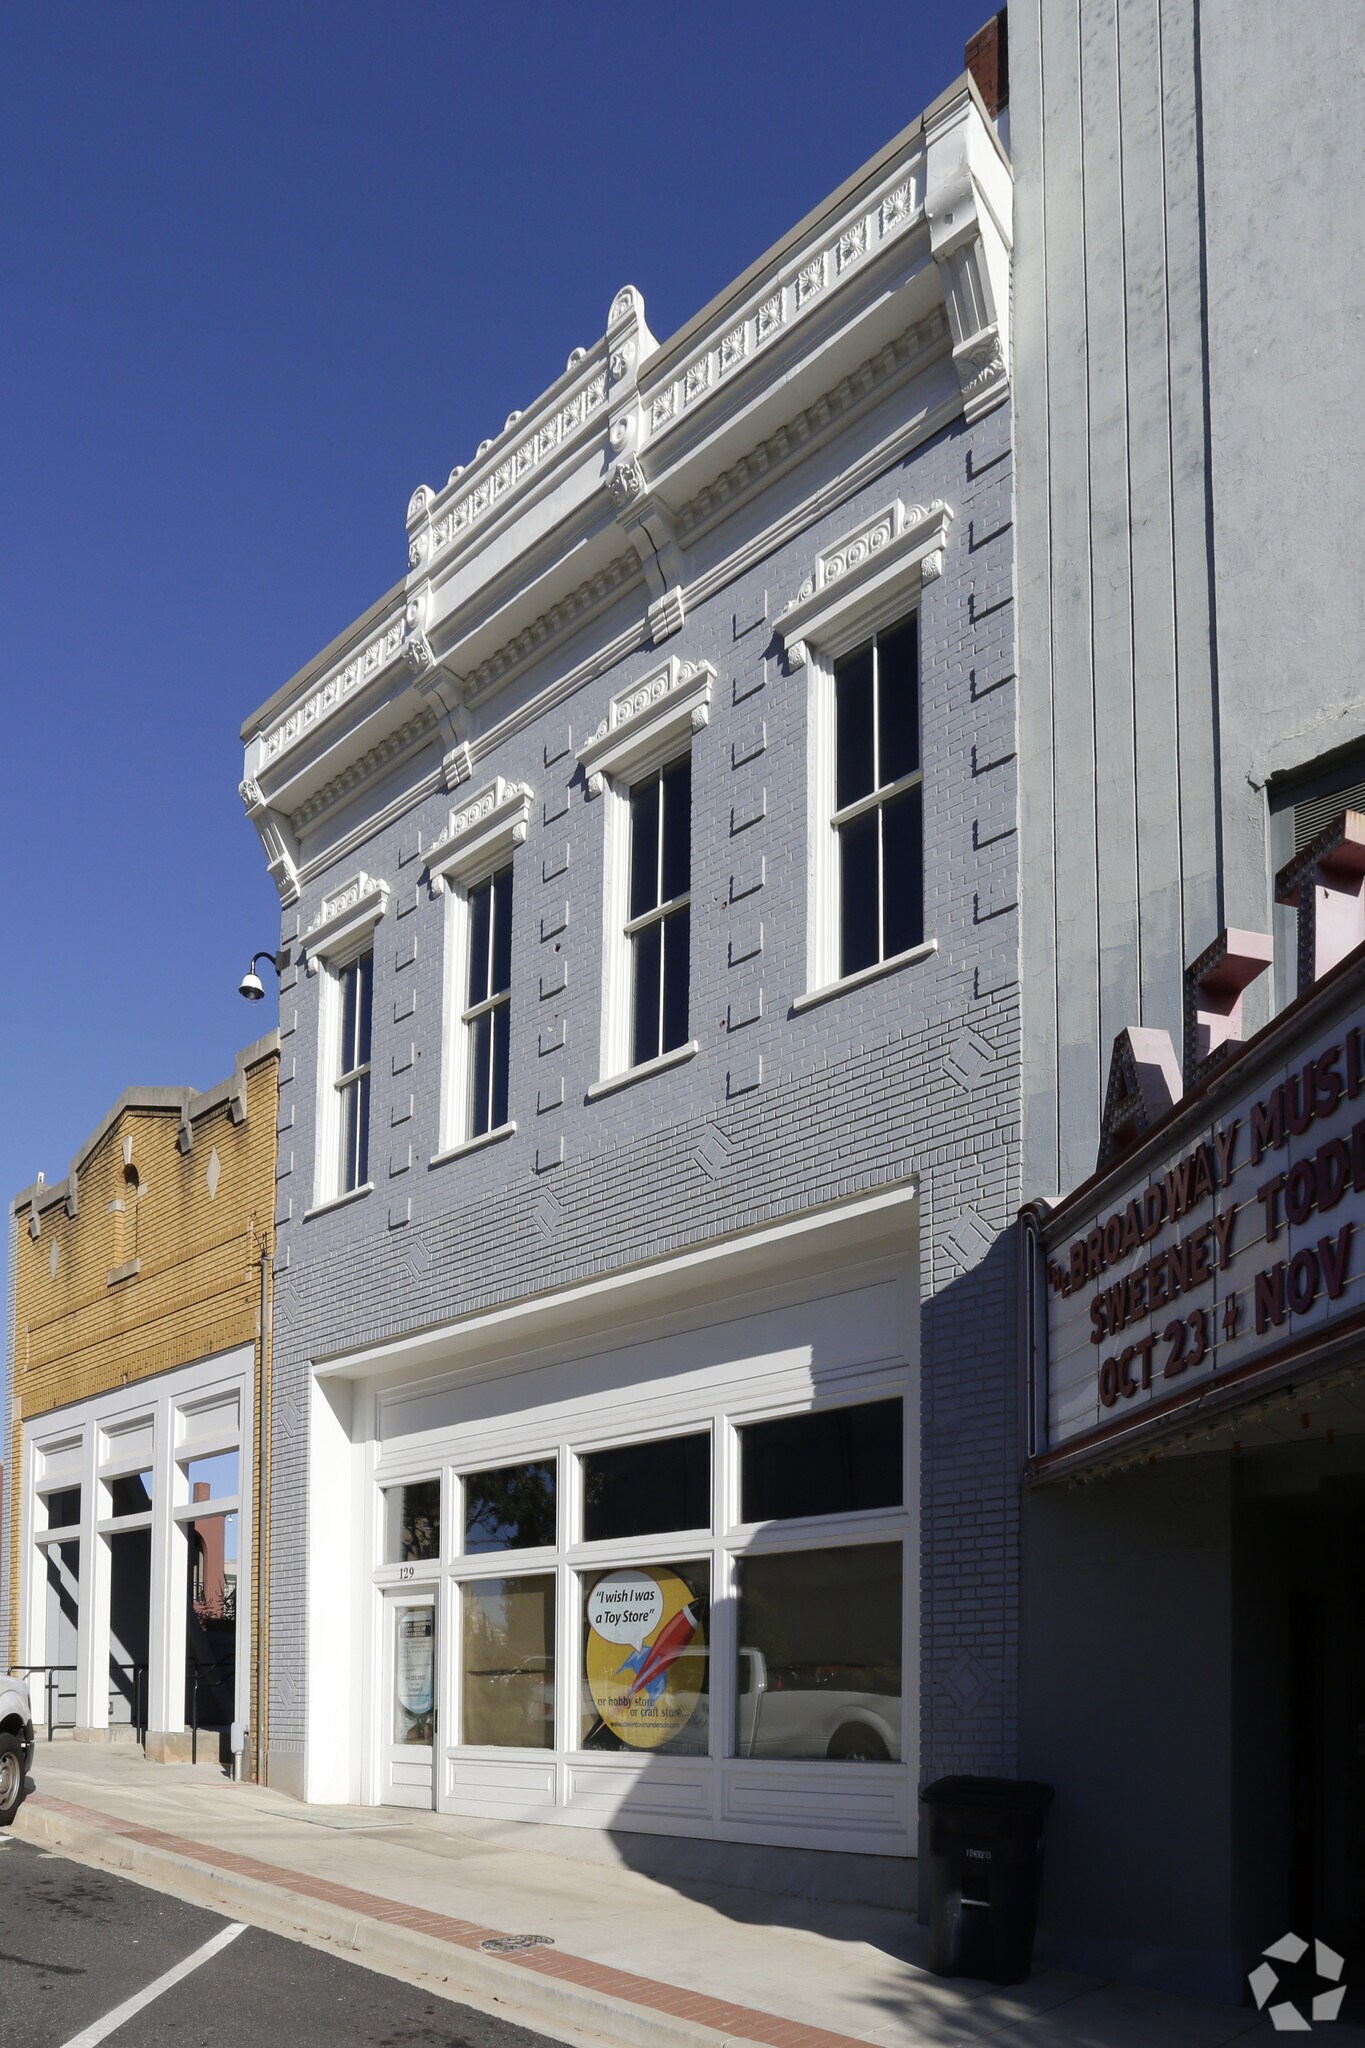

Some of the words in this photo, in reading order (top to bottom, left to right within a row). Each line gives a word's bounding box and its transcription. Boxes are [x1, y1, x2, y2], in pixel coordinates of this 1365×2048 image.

[1069, 1118, 1241, 1292] BROADWAY
[1250, 1025, 1365, 1167] MUSI
[1089, 1202, 1238, 1345] SWEENEY
[1099, 1332, 1157, 1408] OCT
[1163, 1308, 1208, 1380] 23
[1255, 1220, 1354, 1336] NOV
[399, 1567, 415, 1580] 129
[605, 1589, 628, 1604] wish
[629, 1589, 634, 1602] I
[635, 1590, 655, 1602] was
[595, 1614, 602, 1624] a
[604, 1611, 622, 1627] Toy
[597, 1698, 606, 1706] or
[608, 1696, 632, 1709] hobby
[635, 1698, 655, 1707] store
[630, 1708, 638, 1717] or
[640, 1706, 659, 1717] craft
